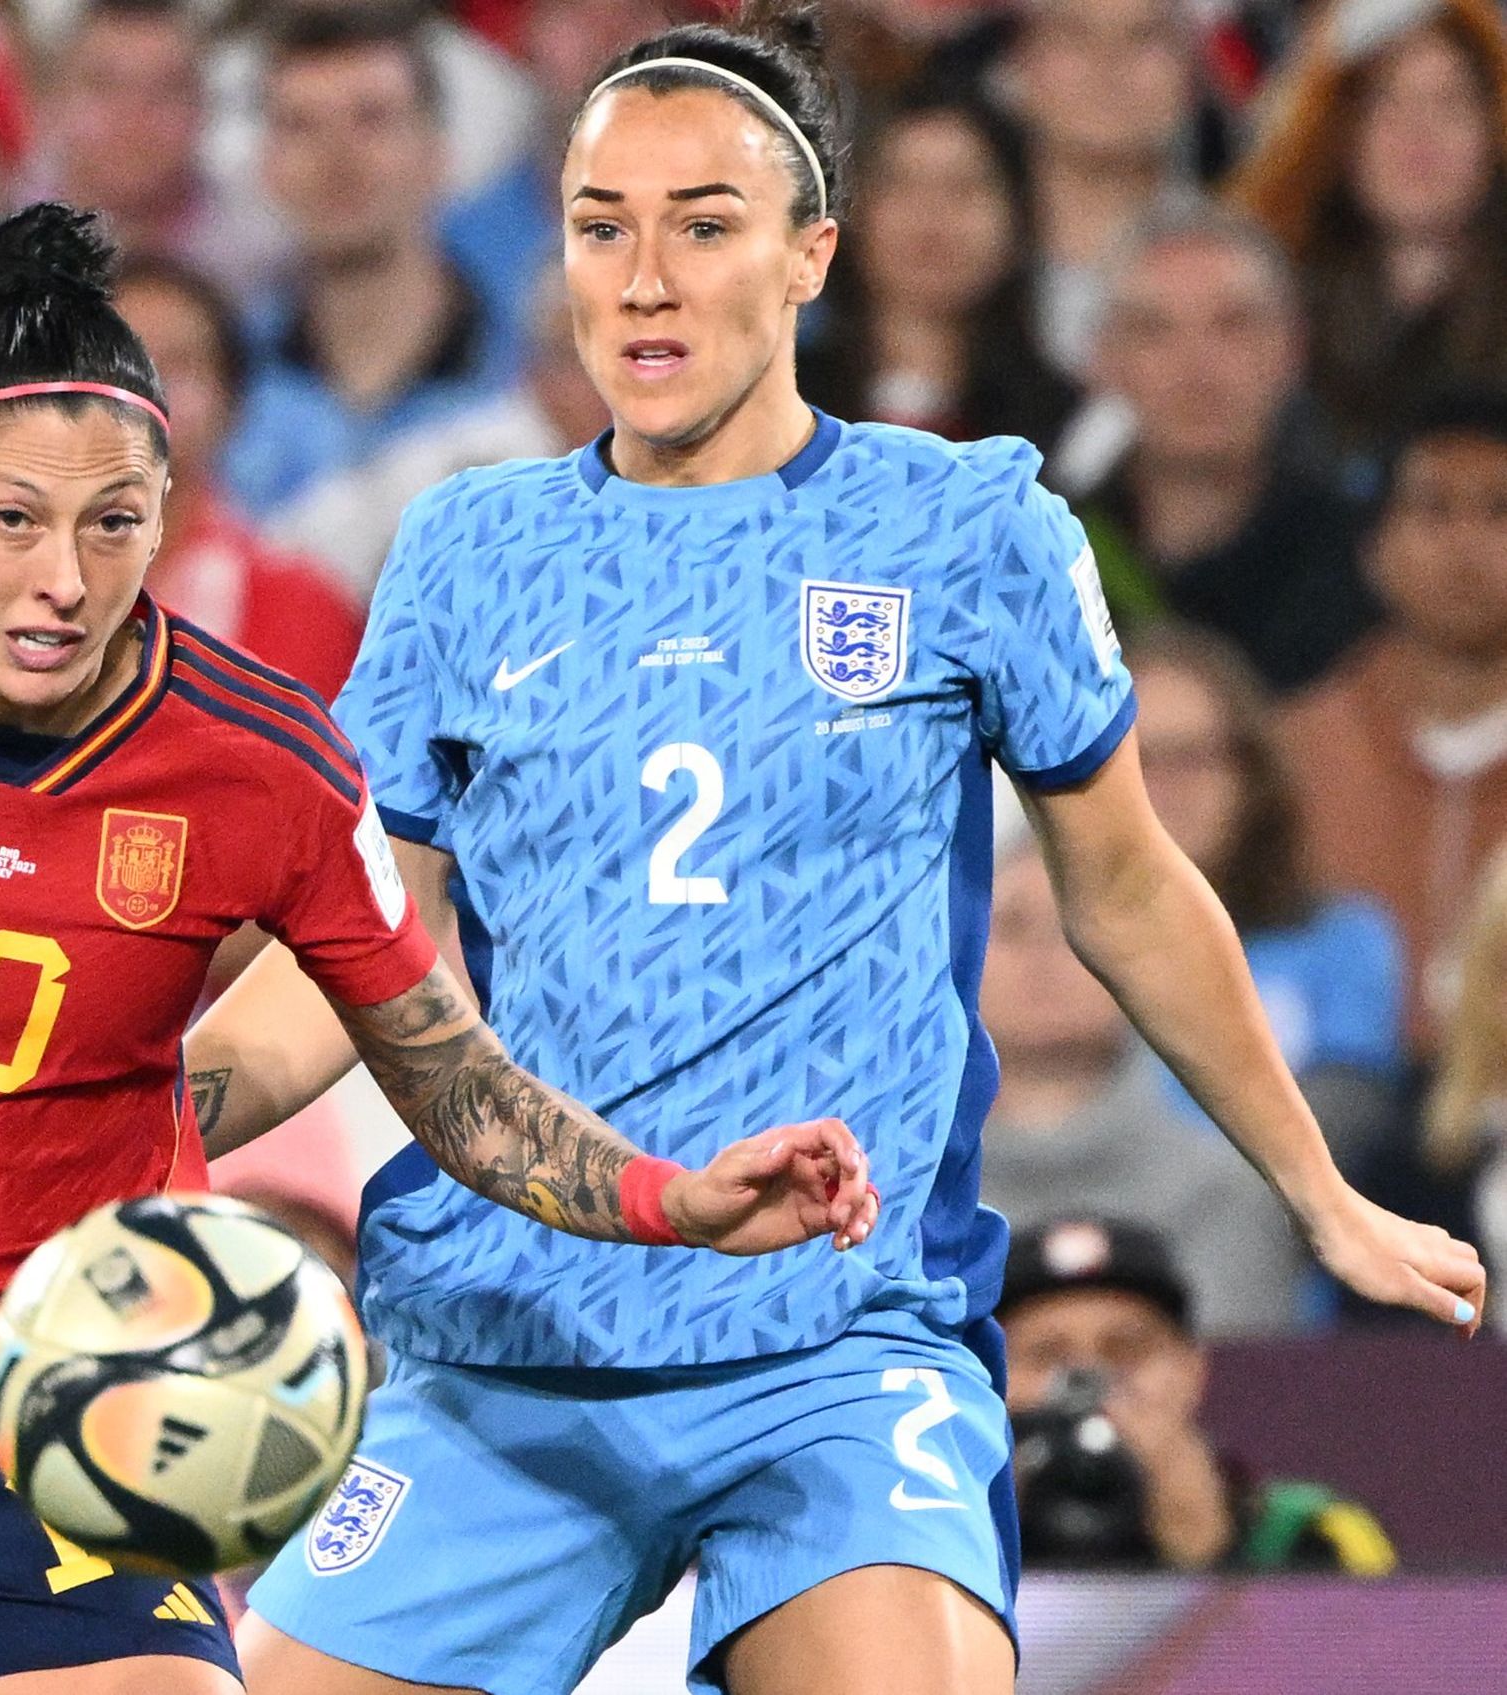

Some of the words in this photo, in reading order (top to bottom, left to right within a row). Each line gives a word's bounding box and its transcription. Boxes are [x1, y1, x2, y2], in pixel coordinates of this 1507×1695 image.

[10, 859, 36, 875] 2023
[641, 742, 729, 904] 2
[881, 1367, 961, 1491] 2
